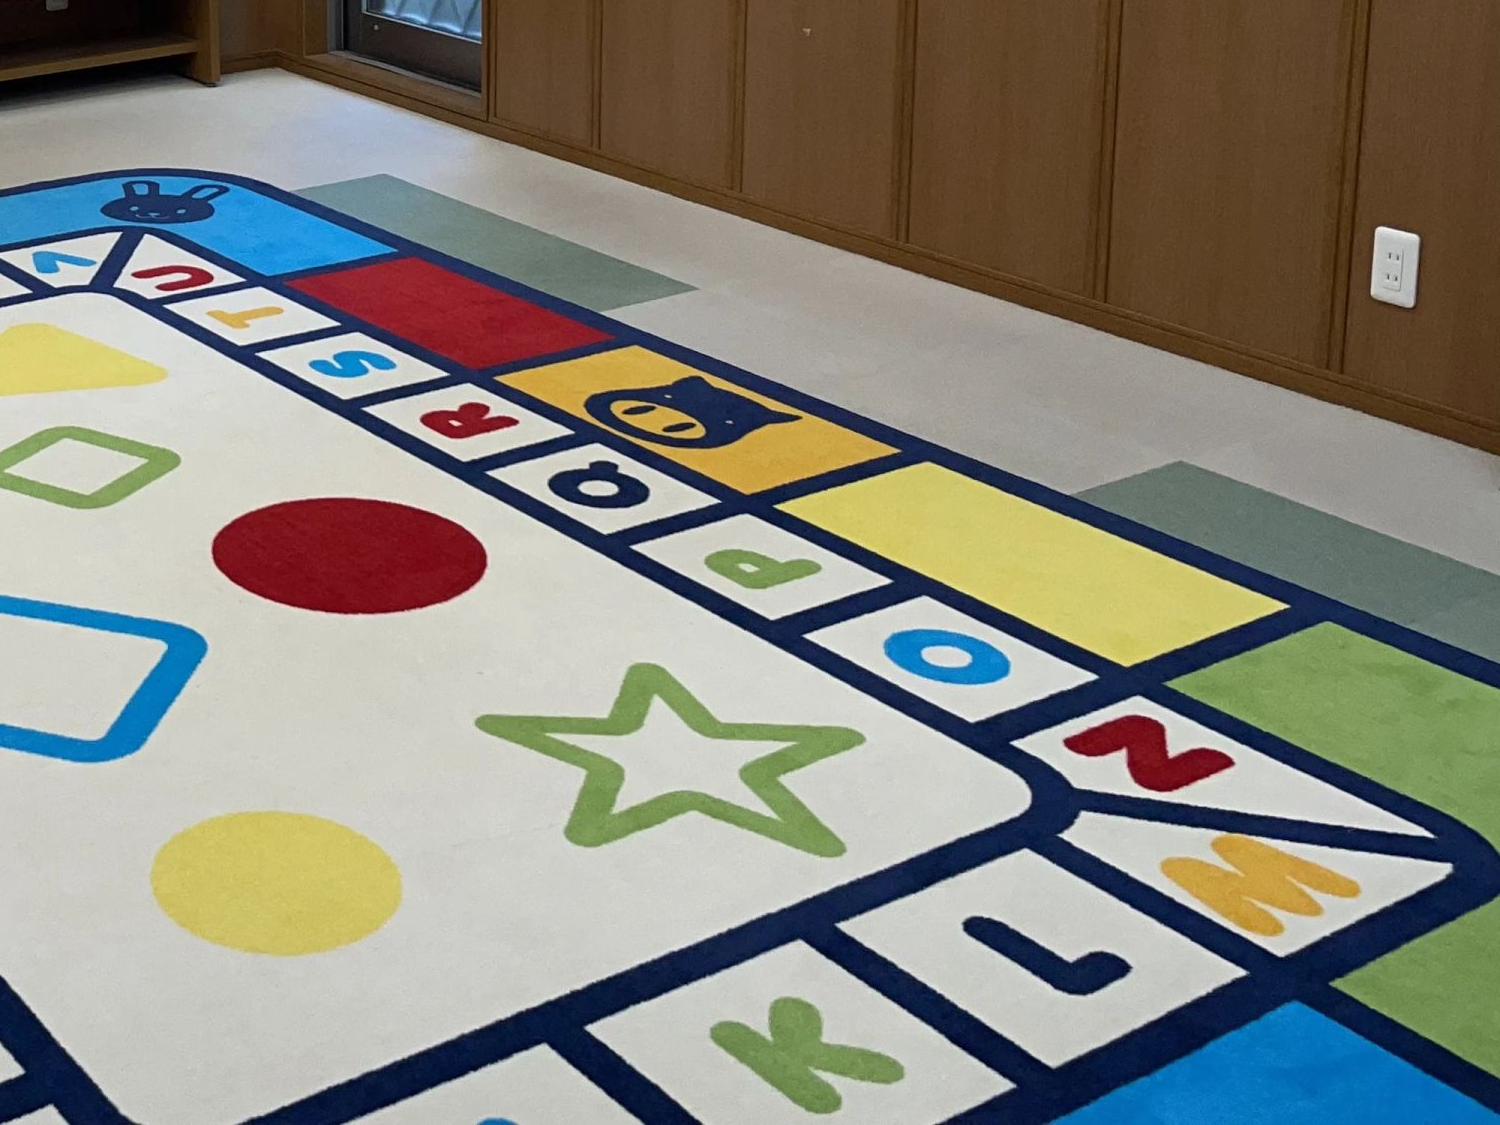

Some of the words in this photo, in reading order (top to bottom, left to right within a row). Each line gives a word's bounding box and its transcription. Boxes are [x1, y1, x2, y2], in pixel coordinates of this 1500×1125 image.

[31, 249, 98, 276] V
[131, 264, 214, 292] U
[206, 305, 284, 331] T
[307, 349, 398, 380] S
[419, 401, 520, 440] R
[547, 460, 650, 509] Q
[705, 550, 821, 589] P
[882, 628, 1012, 687] O
[711, 999, 903, 1114] K
[962, 916, 1133, 997] L
[1160, 833, 1362, 937] M
